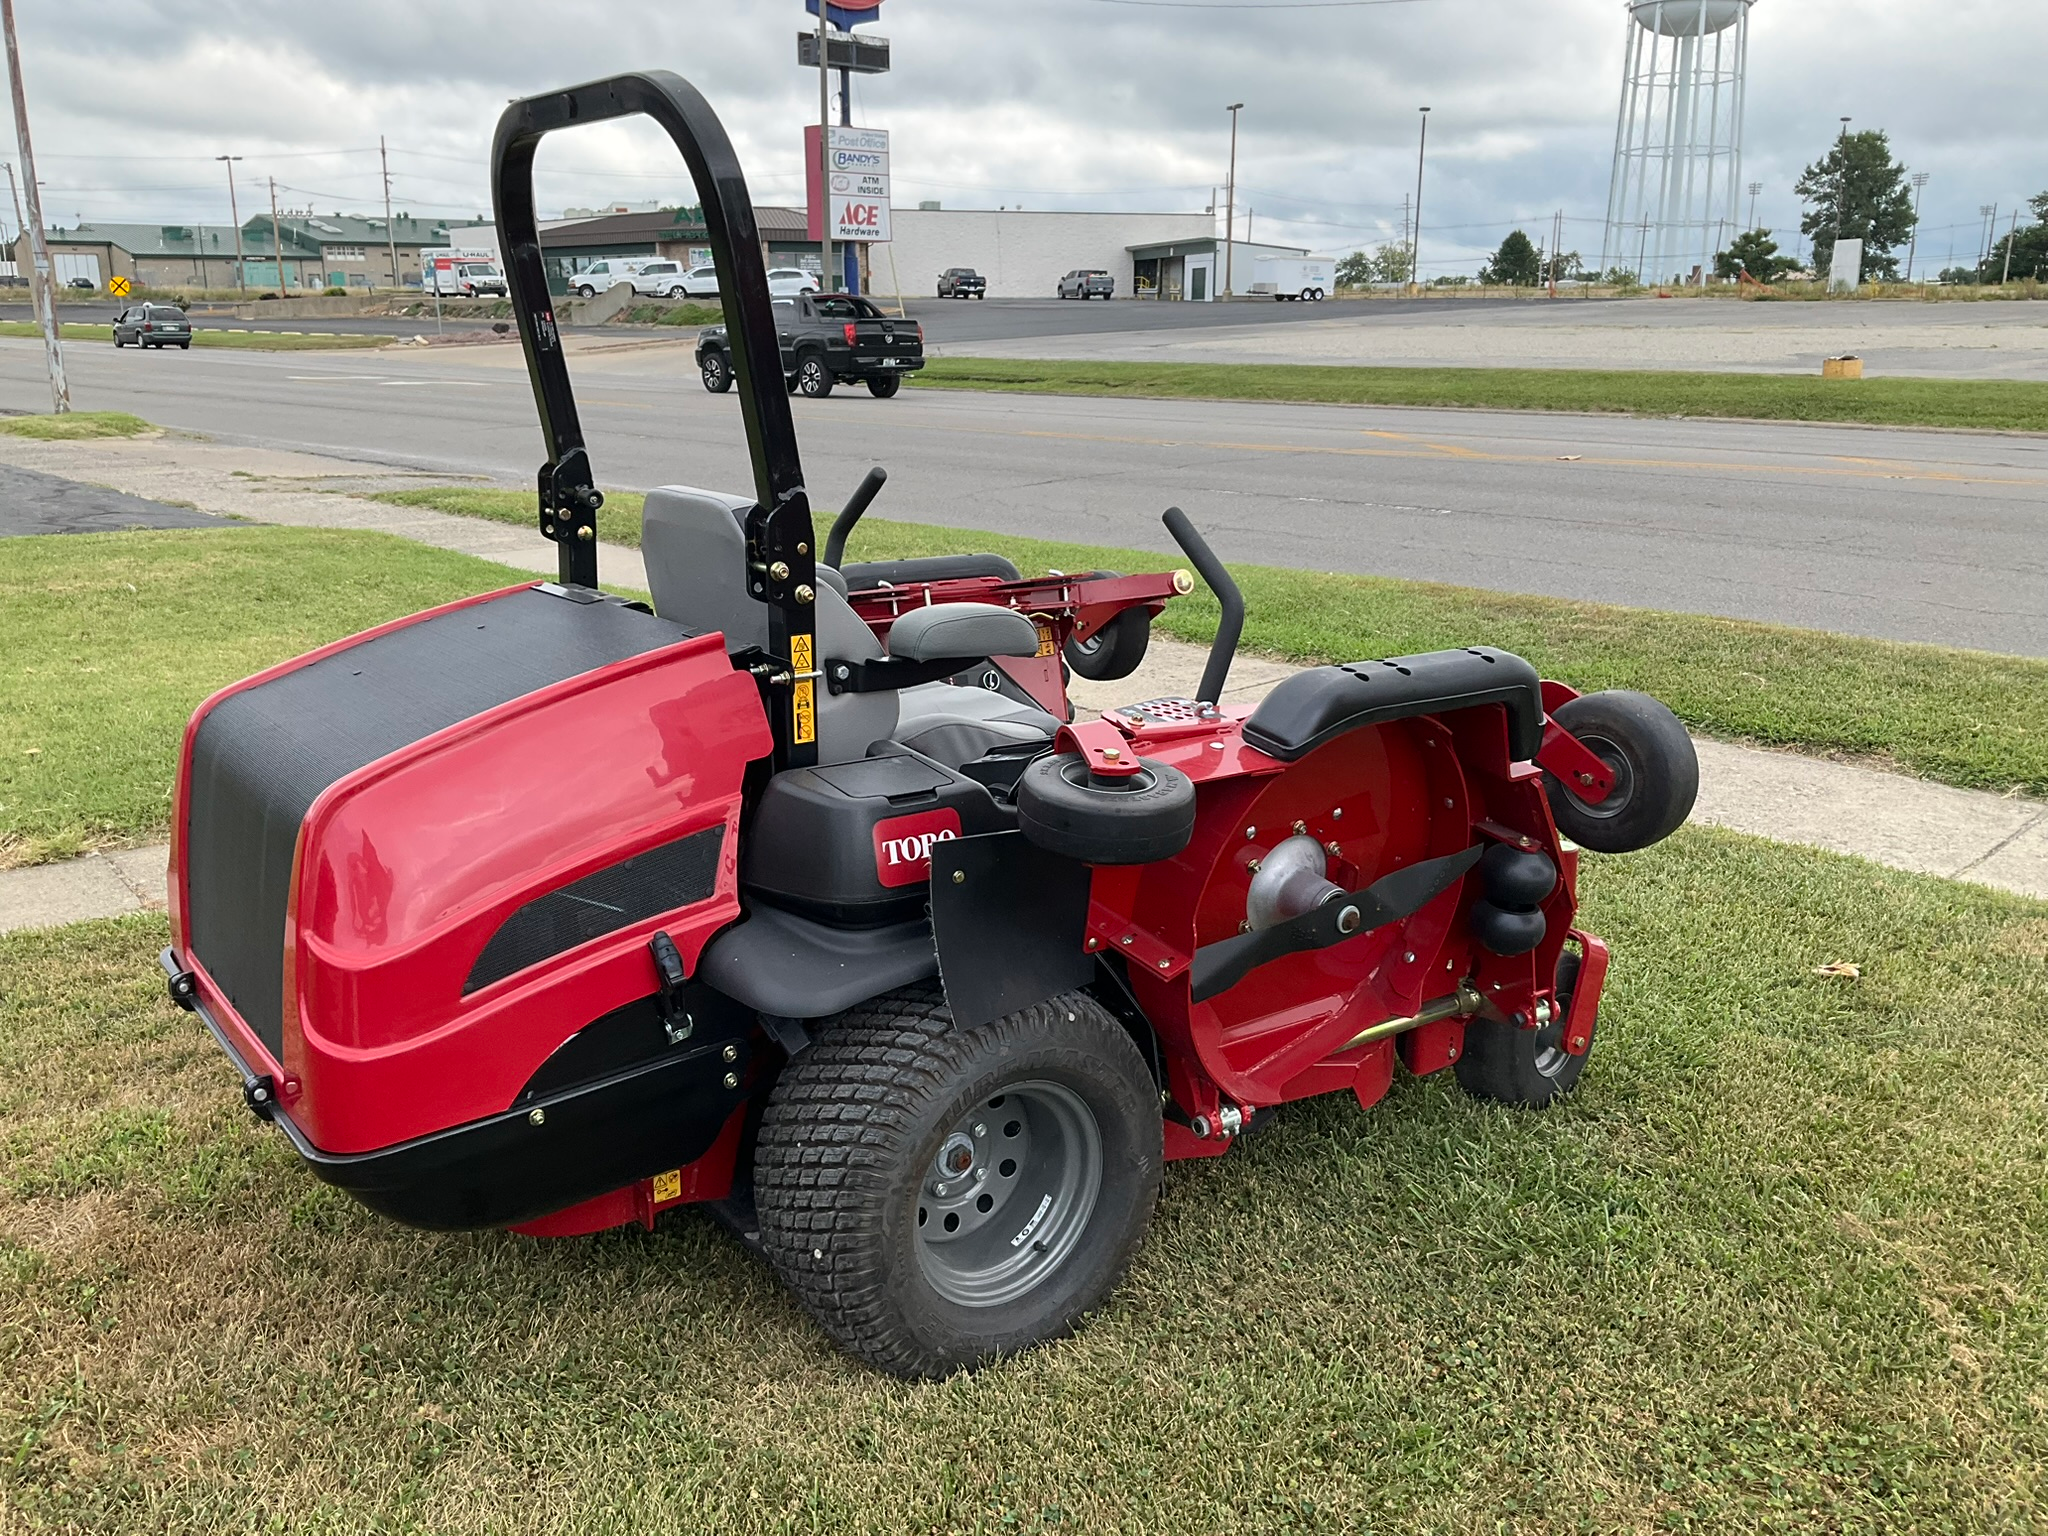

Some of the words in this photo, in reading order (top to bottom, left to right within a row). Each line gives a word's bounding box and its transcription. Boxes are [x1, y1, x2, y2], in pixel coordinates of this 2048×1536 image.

[838, 135, 859, 146] Post
[860, 137, 886, 149] Office
[838, 152, 880, 165] BANDY'S
[862, 176, 879, 184] ATM
[857, 186, 884, 195] INSIDE
[839, 200, 879, 226] ACE
[839, 226, 880, 236] Hardware
